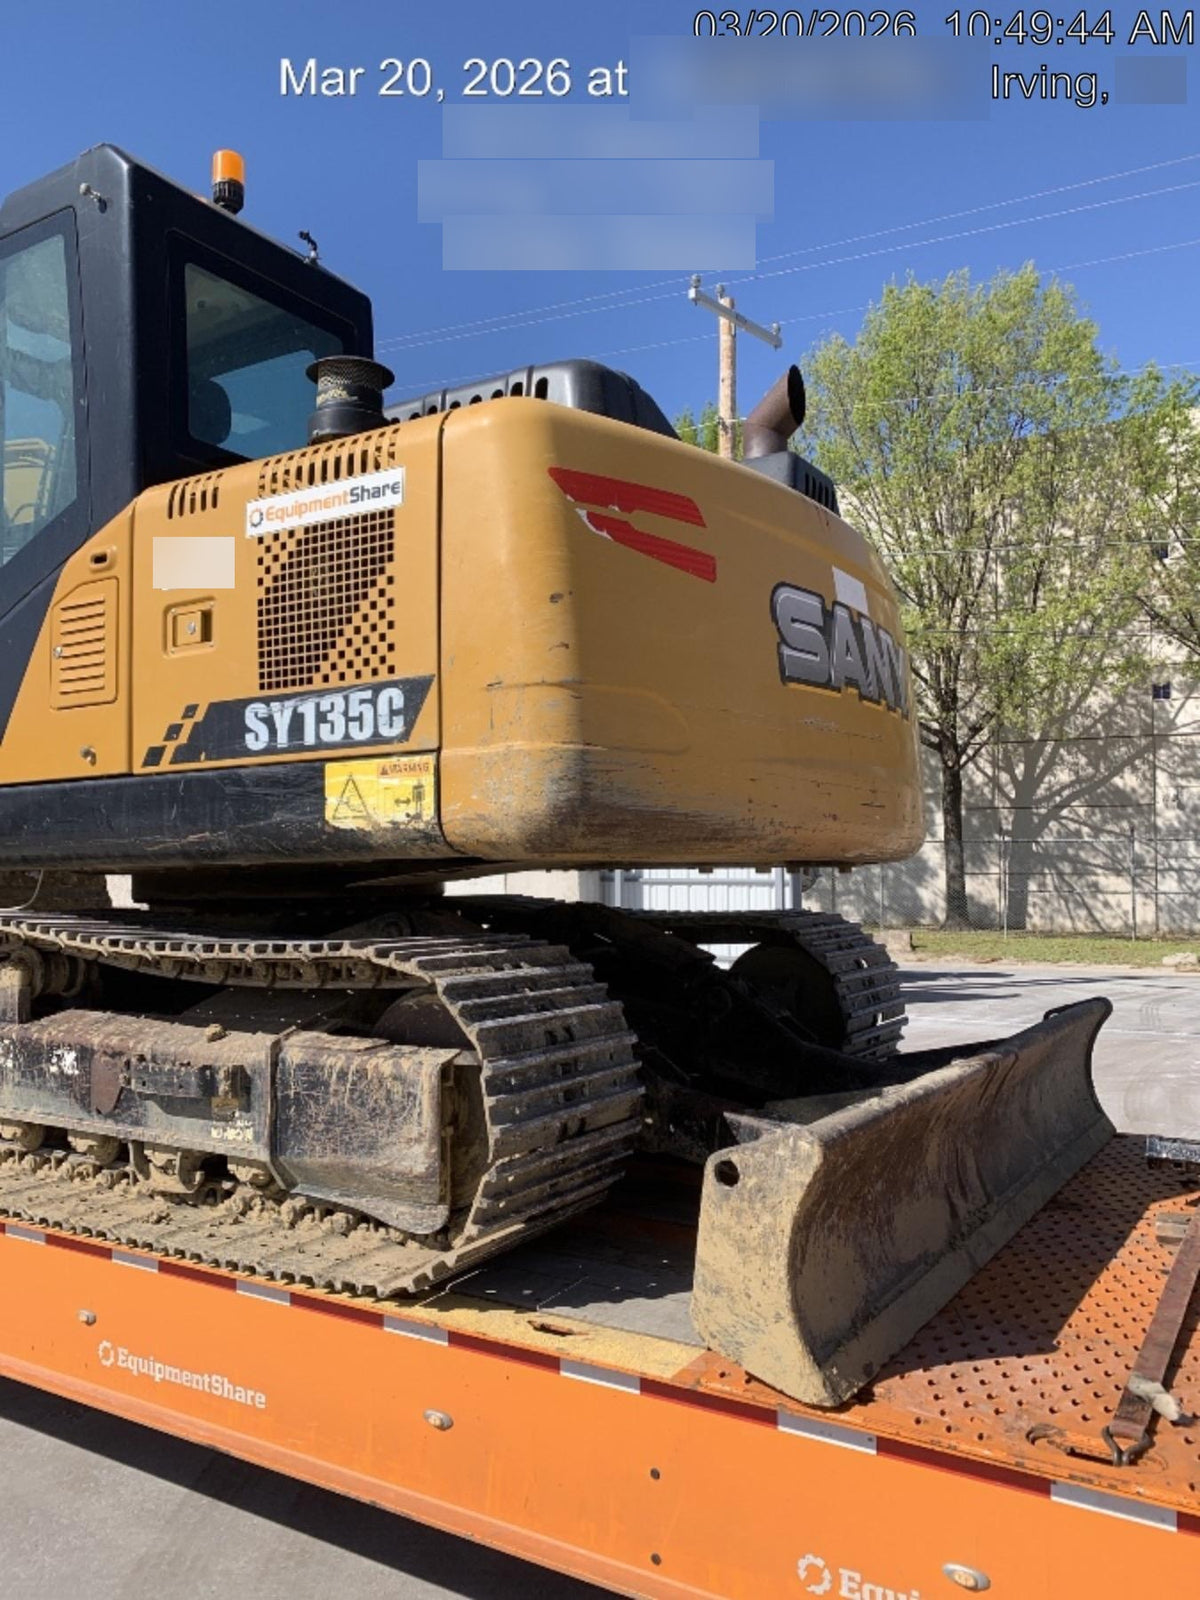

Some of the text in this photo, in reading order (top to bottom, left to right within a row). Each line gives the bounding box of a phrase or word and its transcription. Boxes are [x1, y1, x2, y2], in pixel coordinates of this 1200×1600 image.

[265, 480, 401, 522] EquipmentShare
[244, 687, 405, 751] SY135C
[117, 1347, 266, 1408] EquipmentShare
